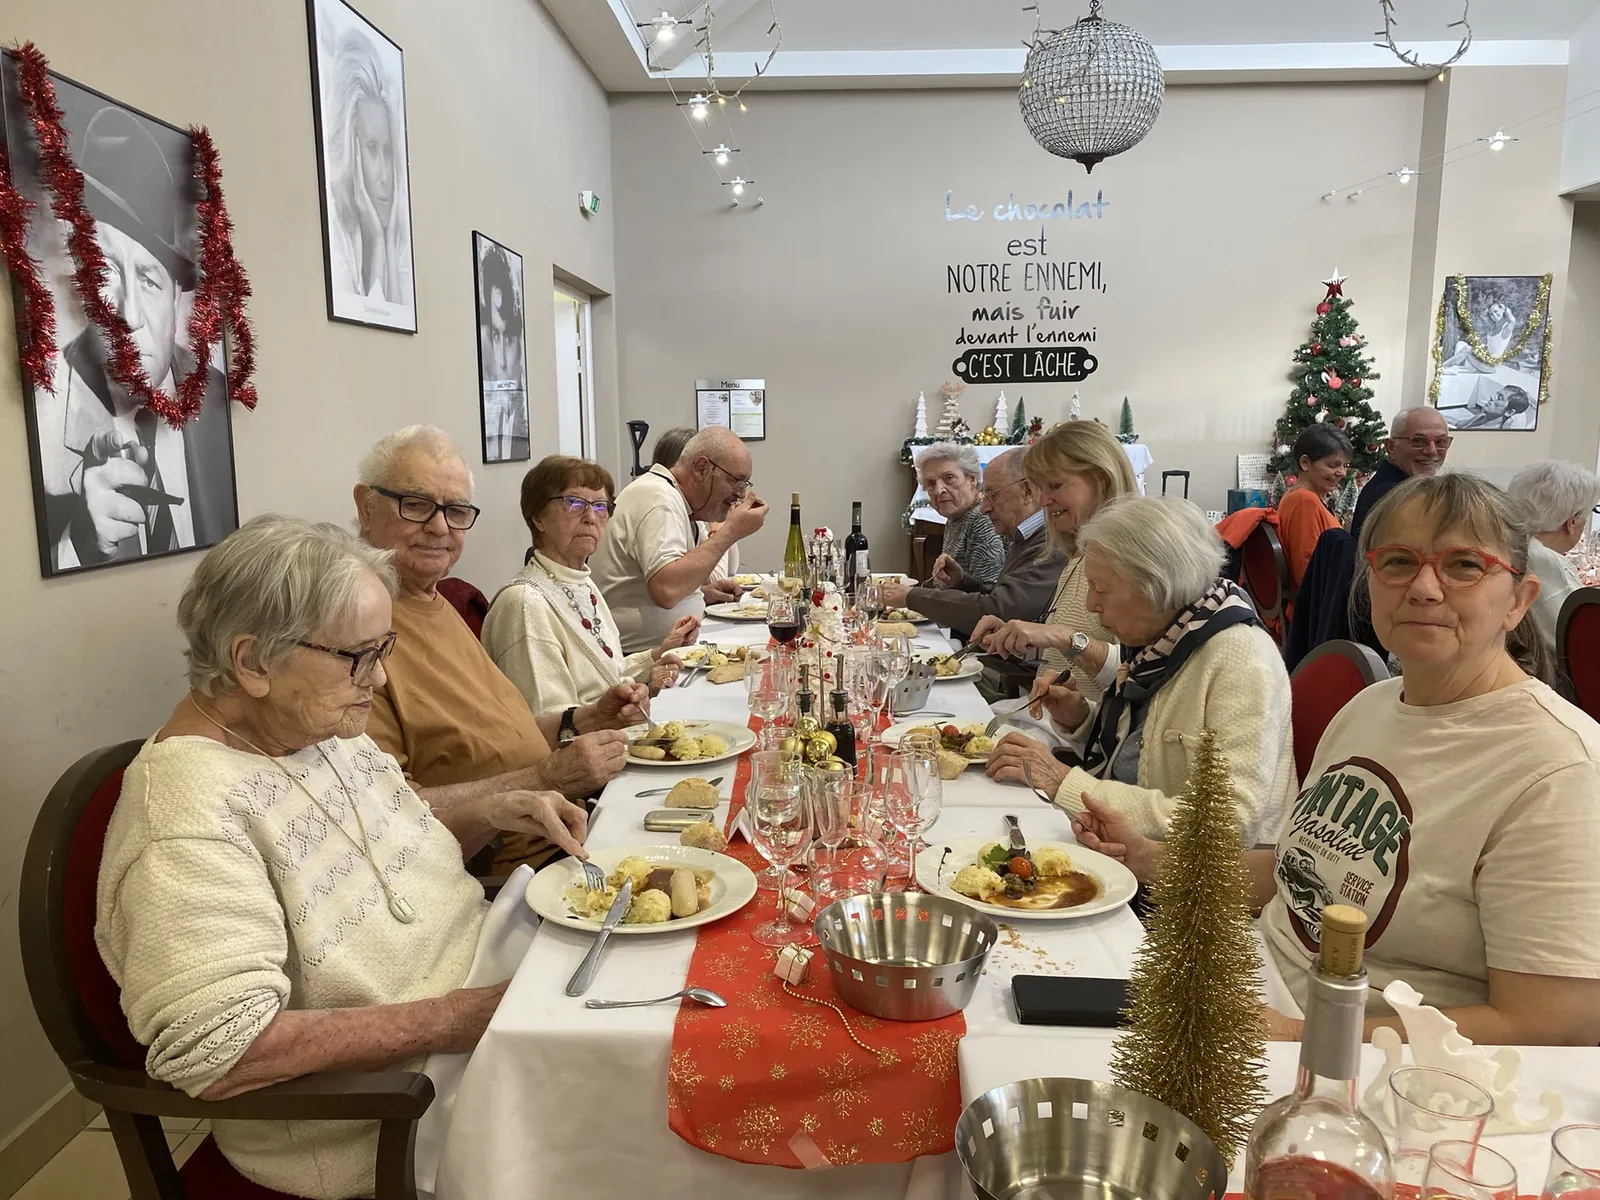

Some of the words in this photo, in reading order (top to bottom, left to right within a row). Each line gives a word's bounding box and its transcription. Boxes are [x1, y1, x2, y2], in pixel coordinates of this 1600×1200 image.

[945, 189, 984, 221] Le
[993, 189, 1110, 221] chocolat
[1007, 224, 1047, 256] est
[947, 263, 1012, 293] NOTRE
[1024, 261, 1107, 293] ENNEMI,
[972, 301, 1024, 321] mais
[1036, 296, 1080, 320] fuir
[955, 326, 1019, 345] devant
[1027, 322, 1097, 343] l'ennemi
[968, 353, 1014, 378] C'EST
[1023, 350, 1081, 377] LÂCHE.
[1289, 813, 1367, 861] gasoline
[1339, 882, 1368, 907] STATION
[1344, 871, 1374, 894] SERVICE
